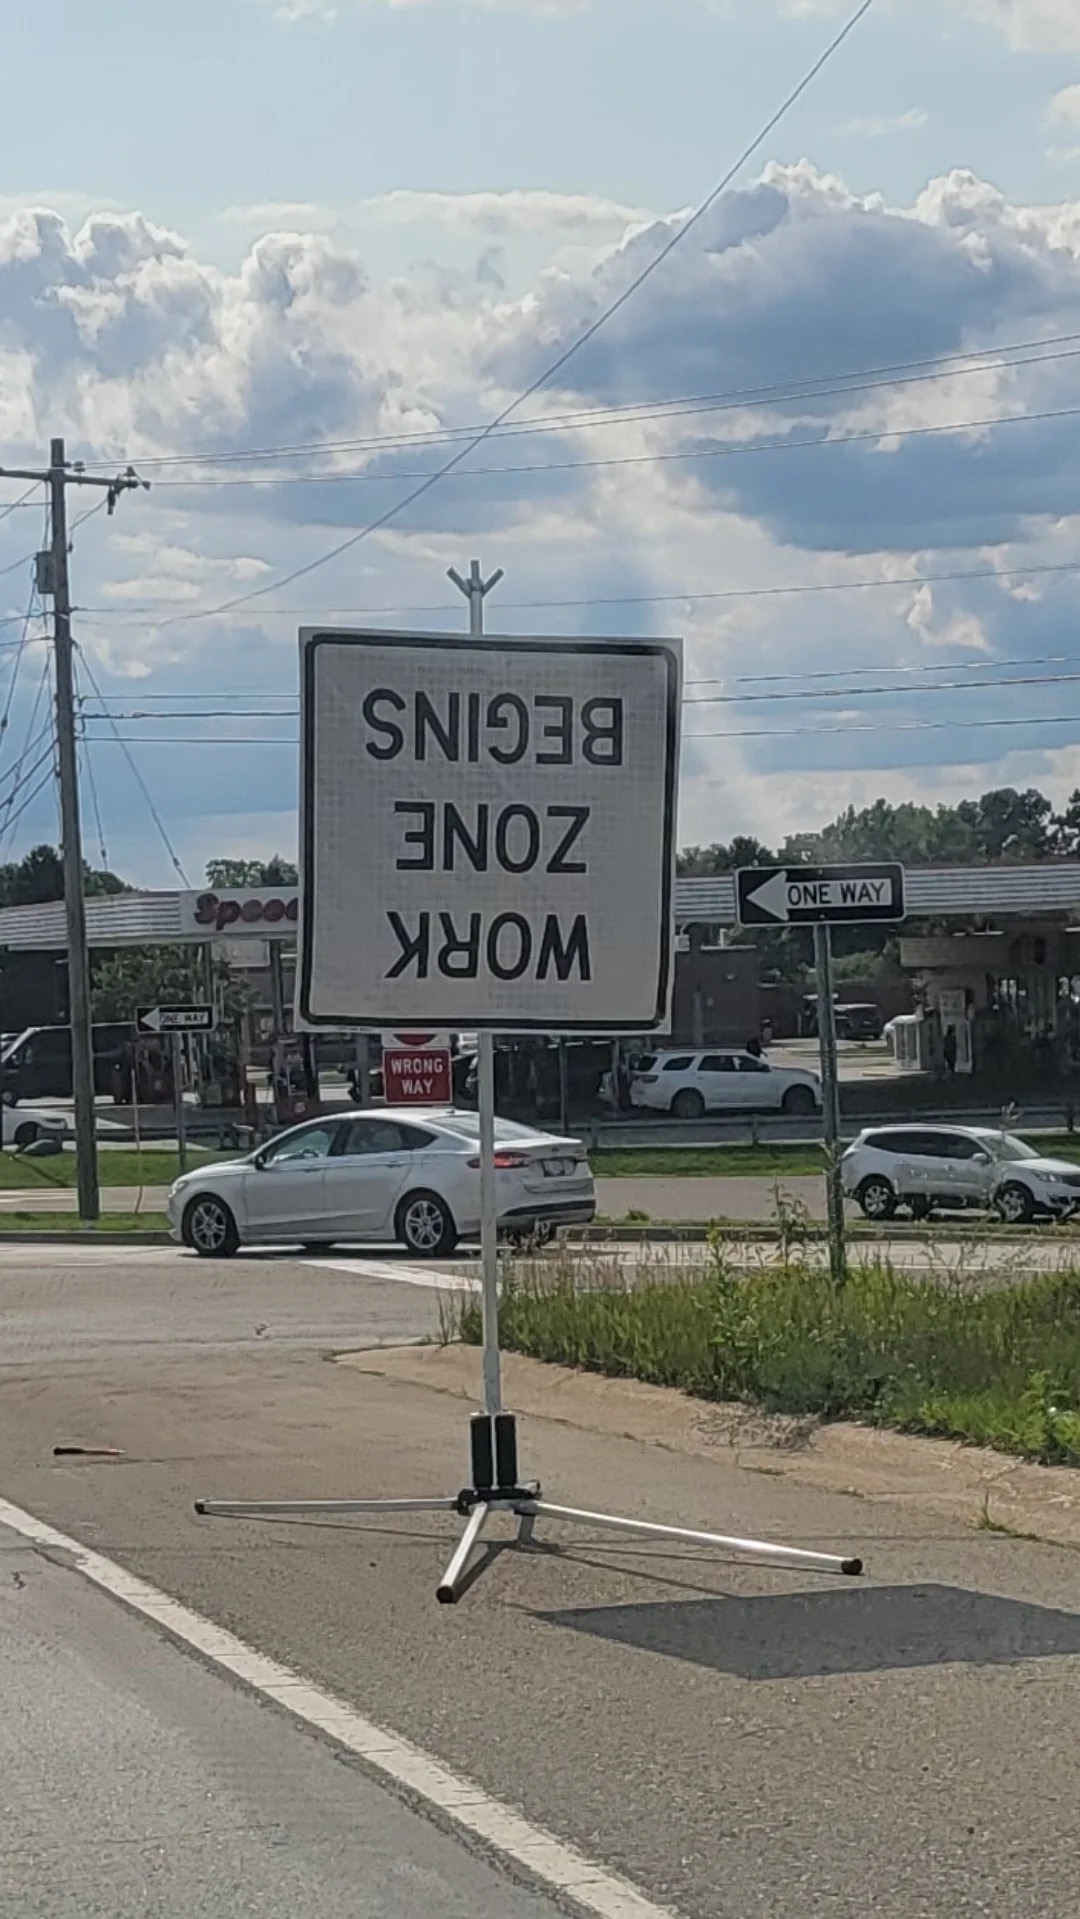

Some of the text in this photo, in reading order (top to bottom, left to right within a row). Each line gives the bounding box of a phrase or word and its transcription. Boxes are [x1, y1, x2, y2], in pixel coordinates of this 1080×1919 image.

[362, 688, 623, 766] BEGINS
[394, 801, 590, 873] ZONE
[788, 881, 885, 906] ONE WAY
[385, 911, 590, 981] WORK
[391, 1058, 443, 1075] WRONG
[401, 1078, 433, 1095] WAY
